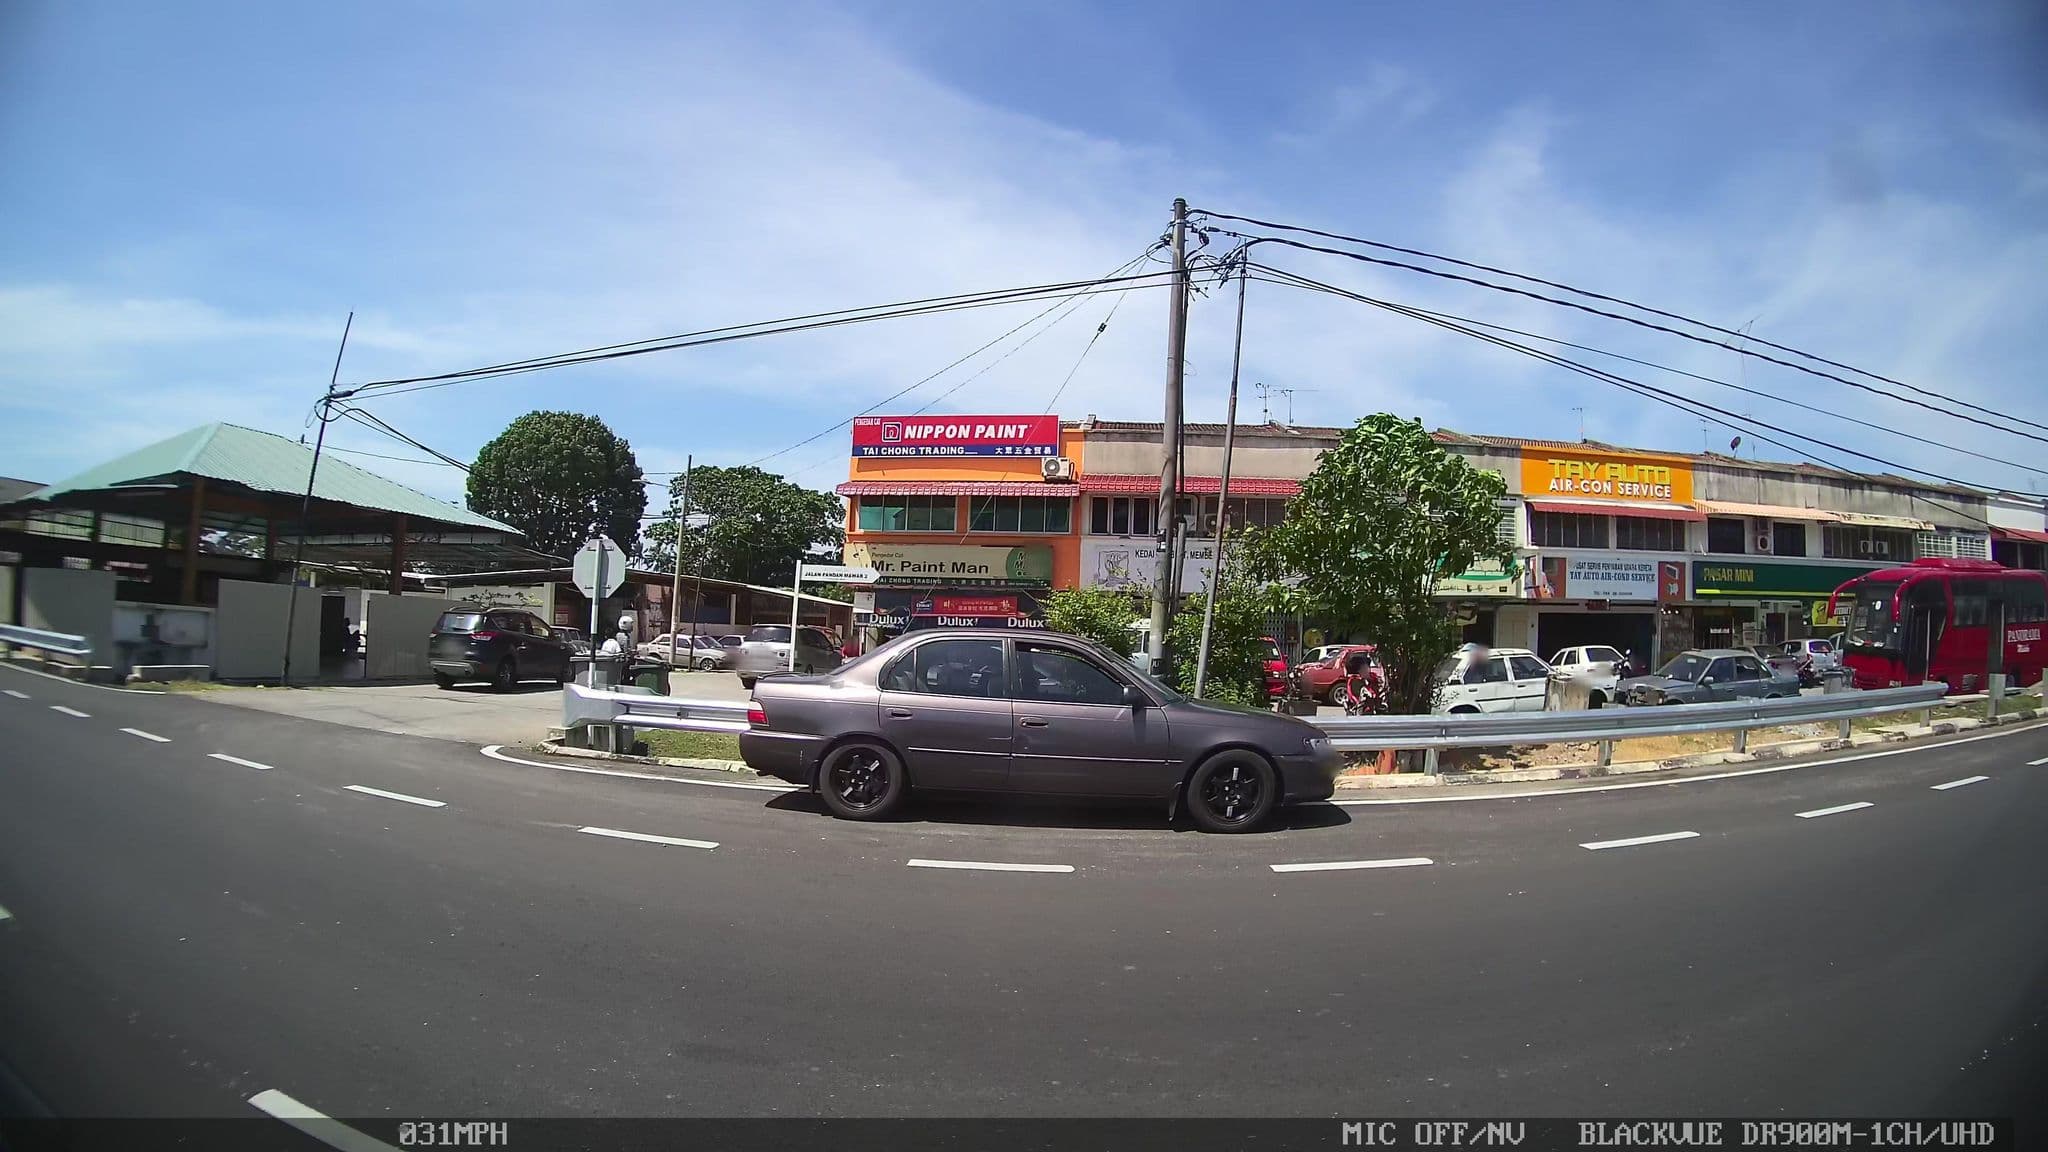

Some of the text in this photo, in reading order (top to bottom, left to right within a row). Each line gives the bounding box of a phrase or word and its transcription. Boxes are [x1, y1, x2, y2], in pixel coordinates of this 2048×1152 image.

[904, 424, 1028, 439] NIPPON PAINT
[863, 447, 878, 455] TAI
[881, 447, 915, 455] CHONG
[919, 447, 964, 455] TRADING
[1548, 458, 1671, 485] TAY AUTO
[1549, 479, 1672, 498] AIR-CON SERVICE
[1135, 550, 1155, 559] KEDAI
[871, 560, 989, 574] Mr. Paint Man
[1570, 571, 1582, 580] TAY
[1583, 572, 1599, 581] AUTO
[869, 613, 1044, 628] Dulux Dulux Dulux
